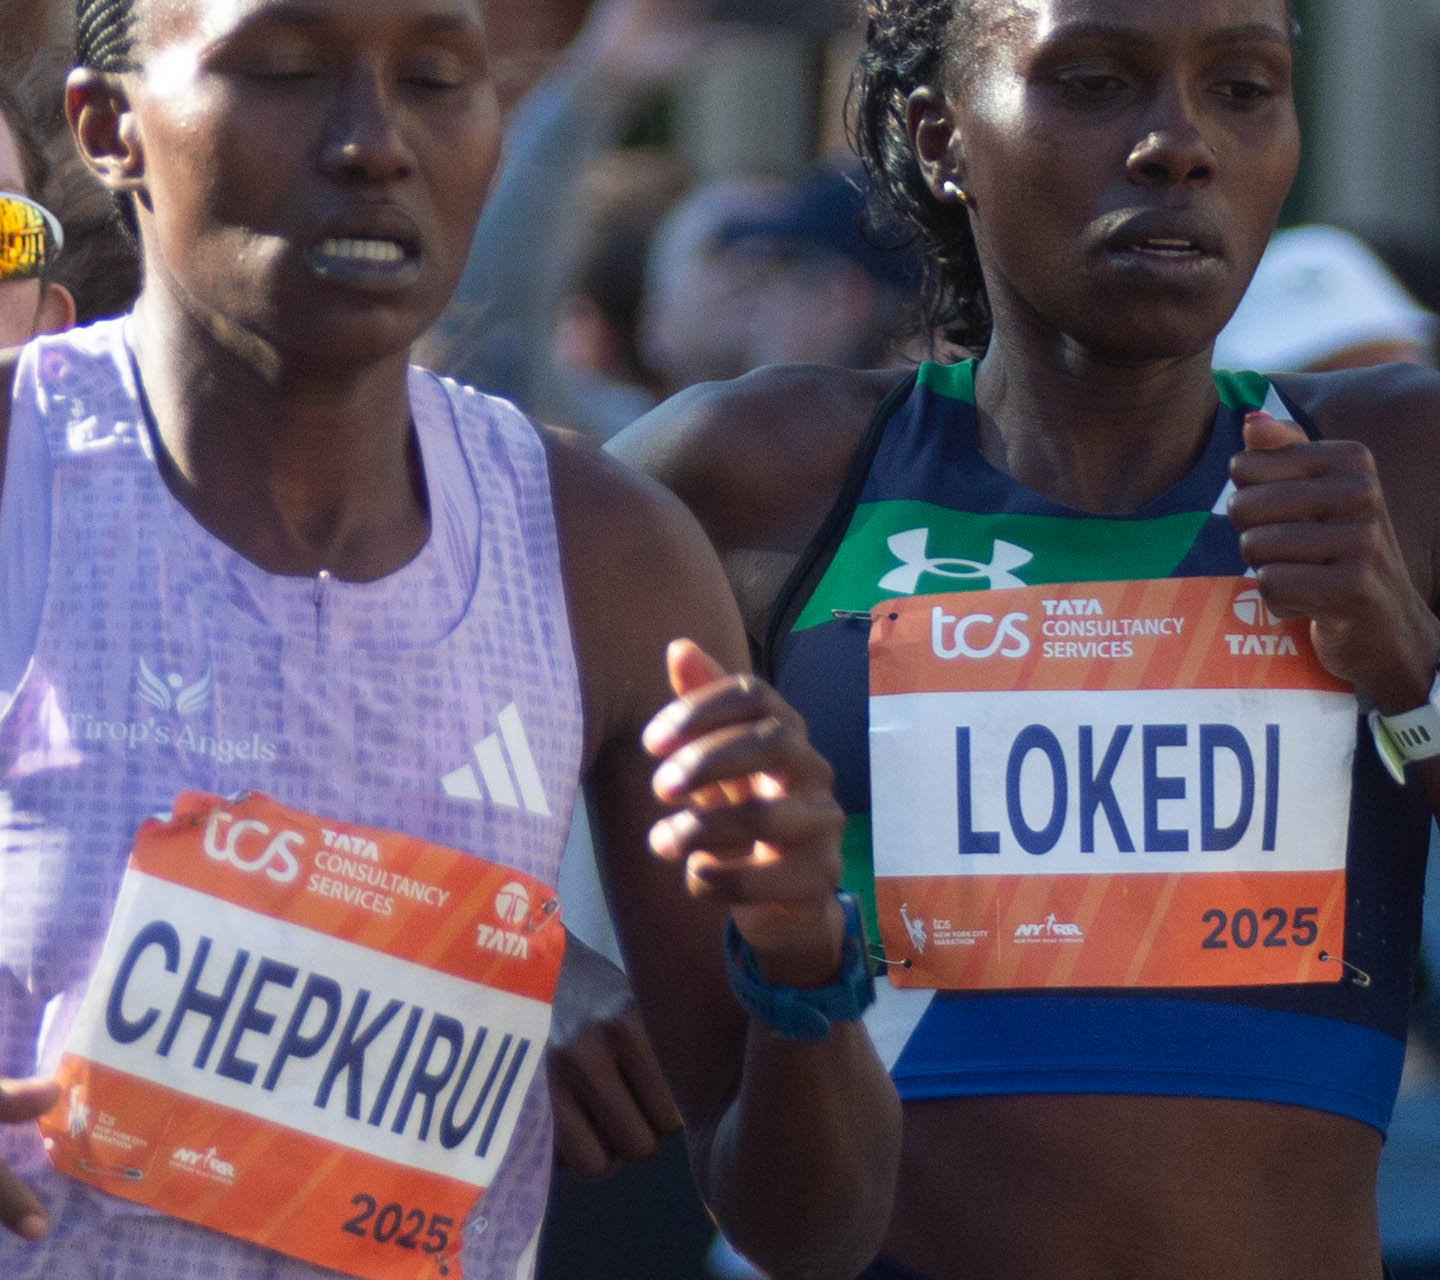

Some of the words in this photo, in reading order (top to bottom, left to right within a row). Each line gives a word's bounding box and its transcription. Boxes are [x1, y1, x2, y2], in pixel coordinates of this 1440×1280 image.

[1041, 599, 1103, 616] TATA
[1041, 616, 1185, 638] CONSULTANCY
[931, 606, 1031, 660] tcs
[1042, 640, 1135, 659] SERVICES
[1224, 634, 1299, 656] TATA
[177, 725, 277, 763] Angels
[956, 723, 1280, 856] LOKEDI
[203, 811, 306, 885] tcs
[321, 829, 379, 860] TATA
[306, 872, 394, 917] SERVICES
[314, 851, 451, 910] CONSULTANCY
[476, 923, 529, 961] TATA
[1201, 907, 1319, 950] 2025
[104, 920, 531, 1159] CHEPKIRUI
[341, 1193, 455, 1256] 2025
